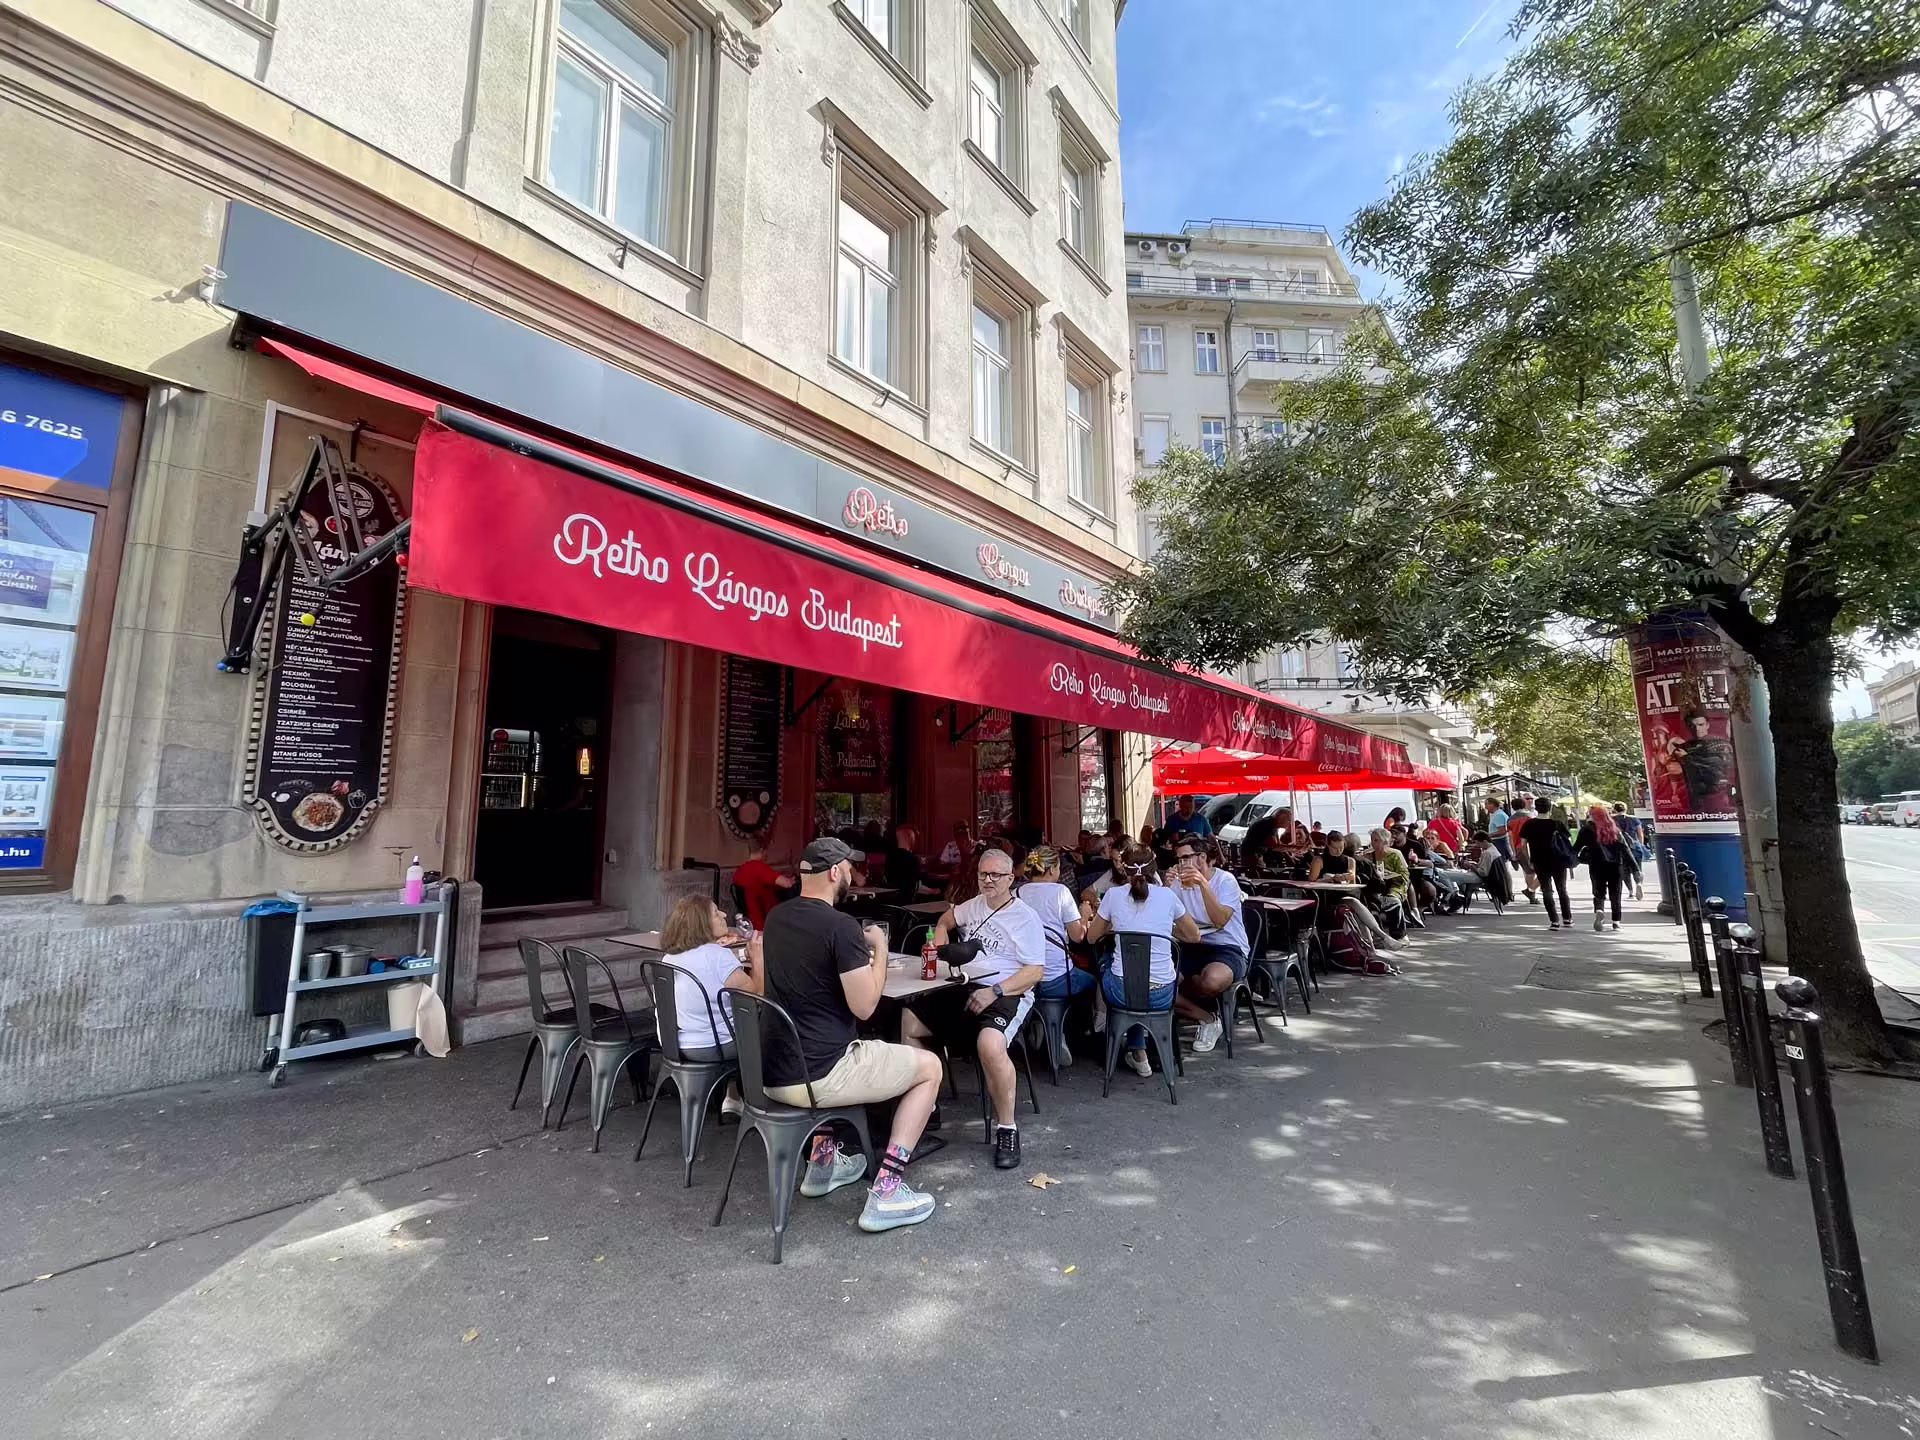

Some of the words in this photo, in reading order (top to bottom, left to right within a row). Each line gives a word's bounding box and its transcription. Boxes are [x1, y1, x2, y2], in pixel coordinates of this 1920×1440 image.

[25, 414, 83, 440] 7625
[845, 487, 908, 537] Retro
[553, 512, 669, 584] Retro
[684, 552, 789, 621] Lángos
[801, 588, 903, 652] Budapest
[281, 681, 316, 689] BOLOGNAI
[1050, 662, 1084, 695] Retro
[1089, 673, 1127, 708] Lángos
[1129, 684, 1171, 719] Budapest
